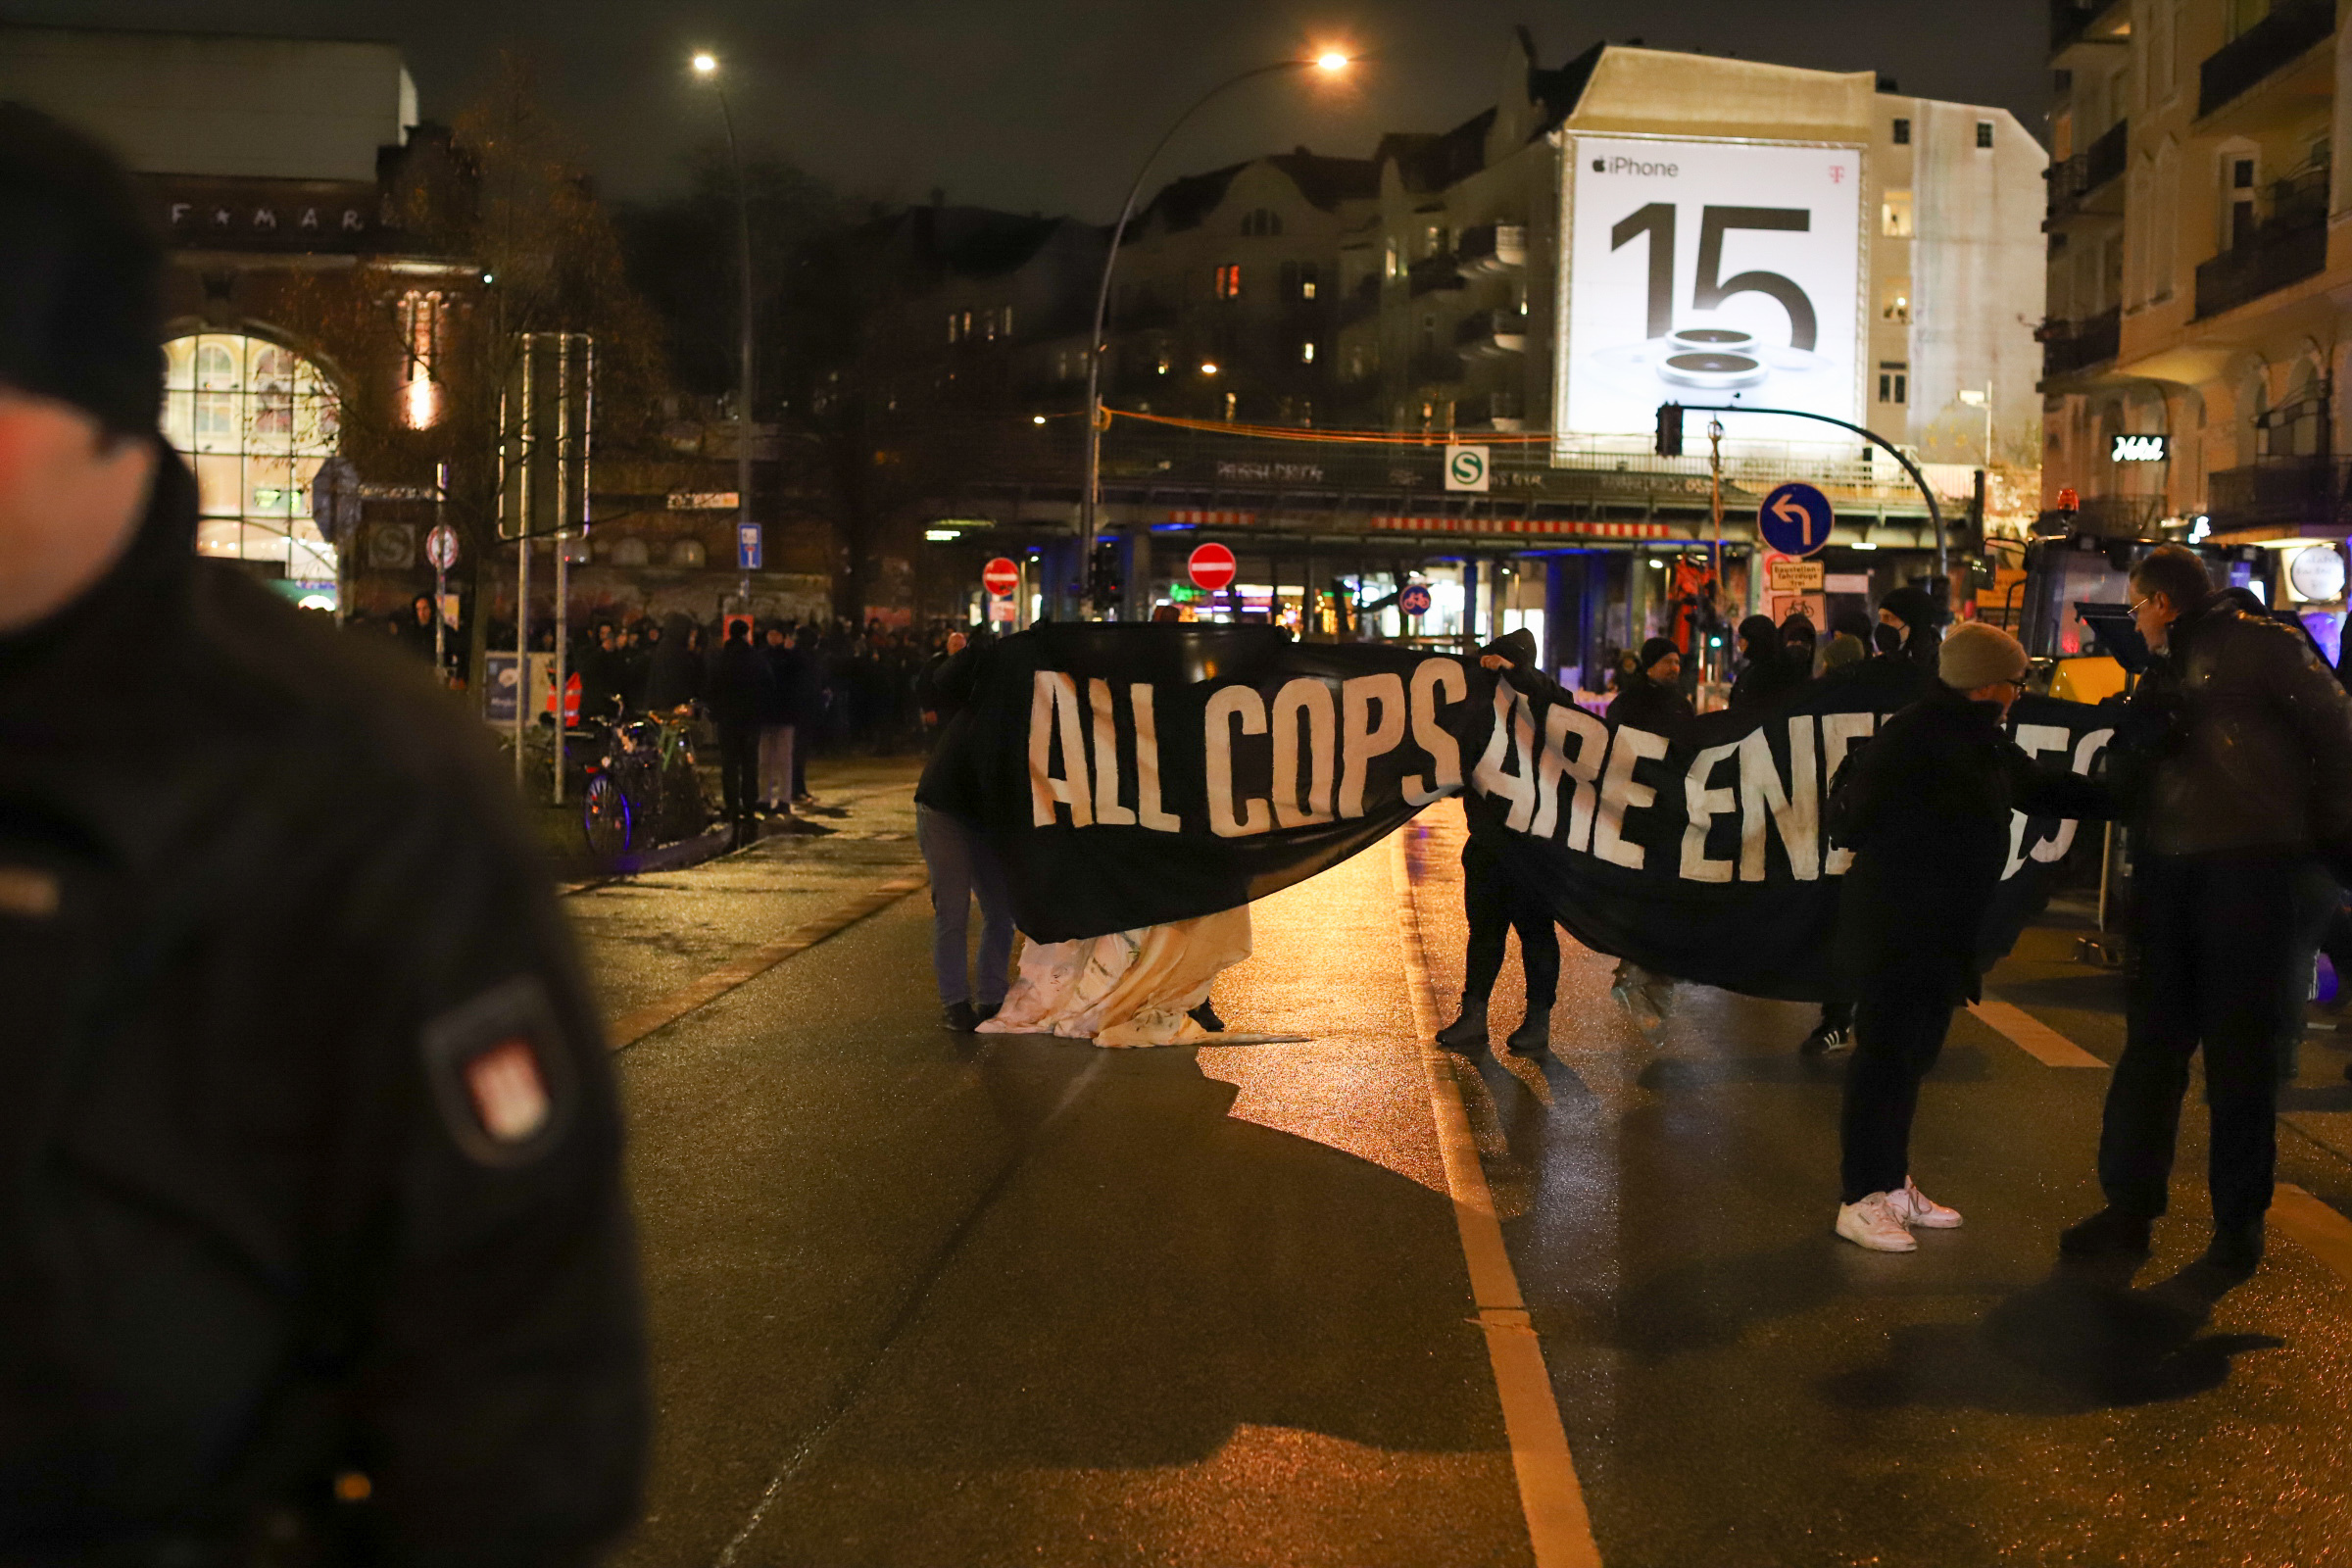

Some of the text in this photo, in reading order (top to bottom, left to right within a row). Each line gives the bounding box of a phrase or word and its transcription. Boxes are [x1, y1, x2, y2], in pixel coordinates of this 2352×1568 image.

[1608, 156, 1679, 177] iPhone
[1611, 202, 1818, 352] 15
[1028, 669, 1182, 833] ALL
[1204, 657, 1468, 838] COPS
[1472, 675, 1669, 870] ARE
